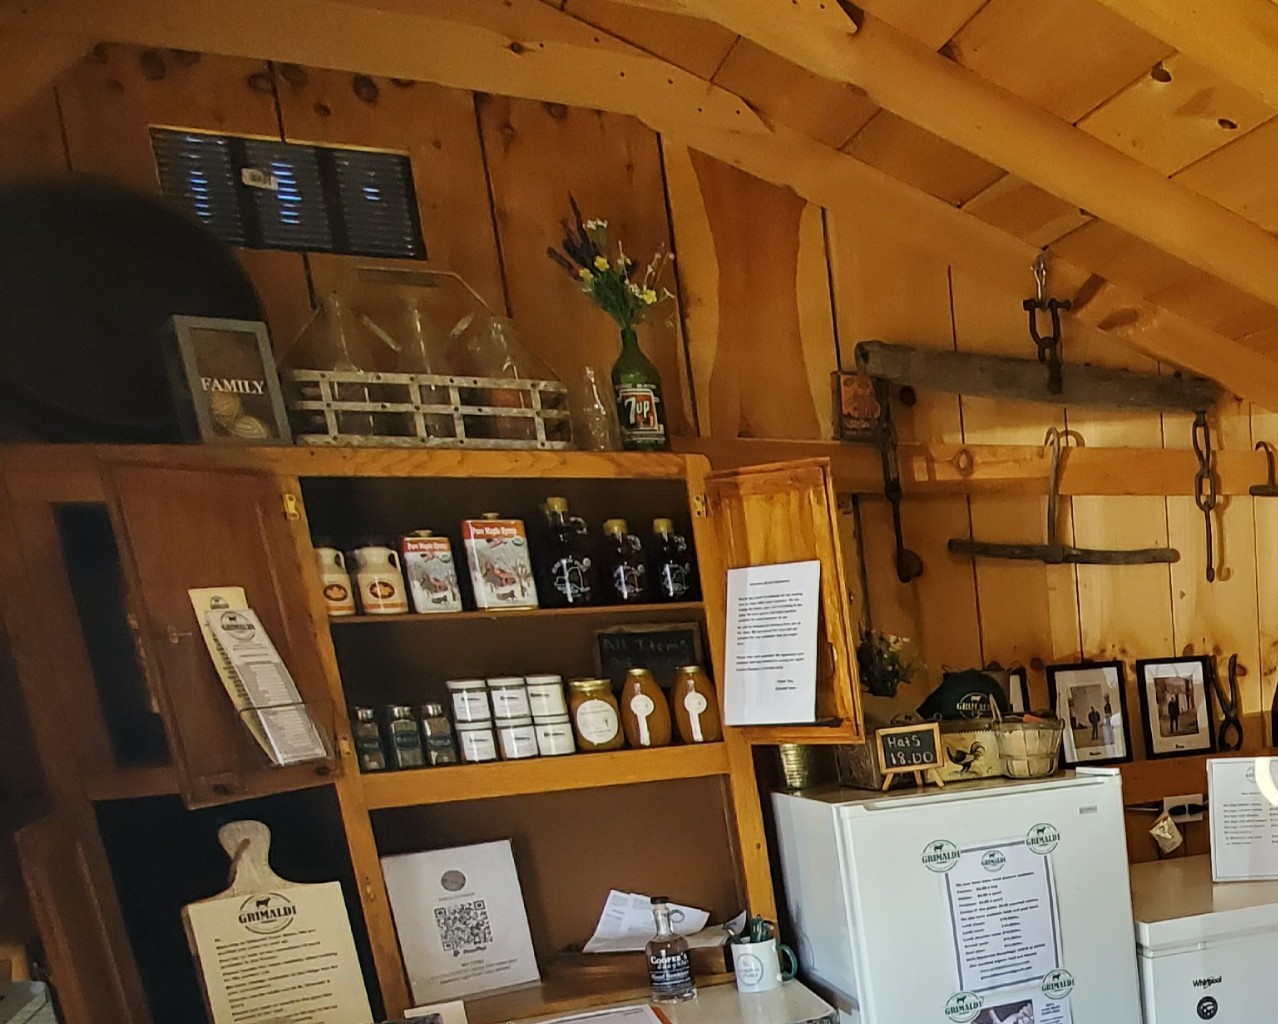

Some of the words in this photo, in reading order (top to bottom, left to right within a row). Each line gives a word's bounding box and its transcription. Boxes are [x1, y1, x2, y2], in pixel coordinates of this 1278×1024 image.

[200, 377, 264, 395] FAMILY
[887, 734, 921, 749] Hats
[890, 750, 934, 766] 18.00
[1025, 832, 1061, 847] GRIMALDI
[922, 850, 961, 864] GRIMALDI
[238, 905, 297, 924] GRIMALDI
[1041, 978, 1075, 992] GRIMALDI
[1192, 974, 1222, 989] Whirlpool
[944, 1000, 982, 1016] GRIMALDI
